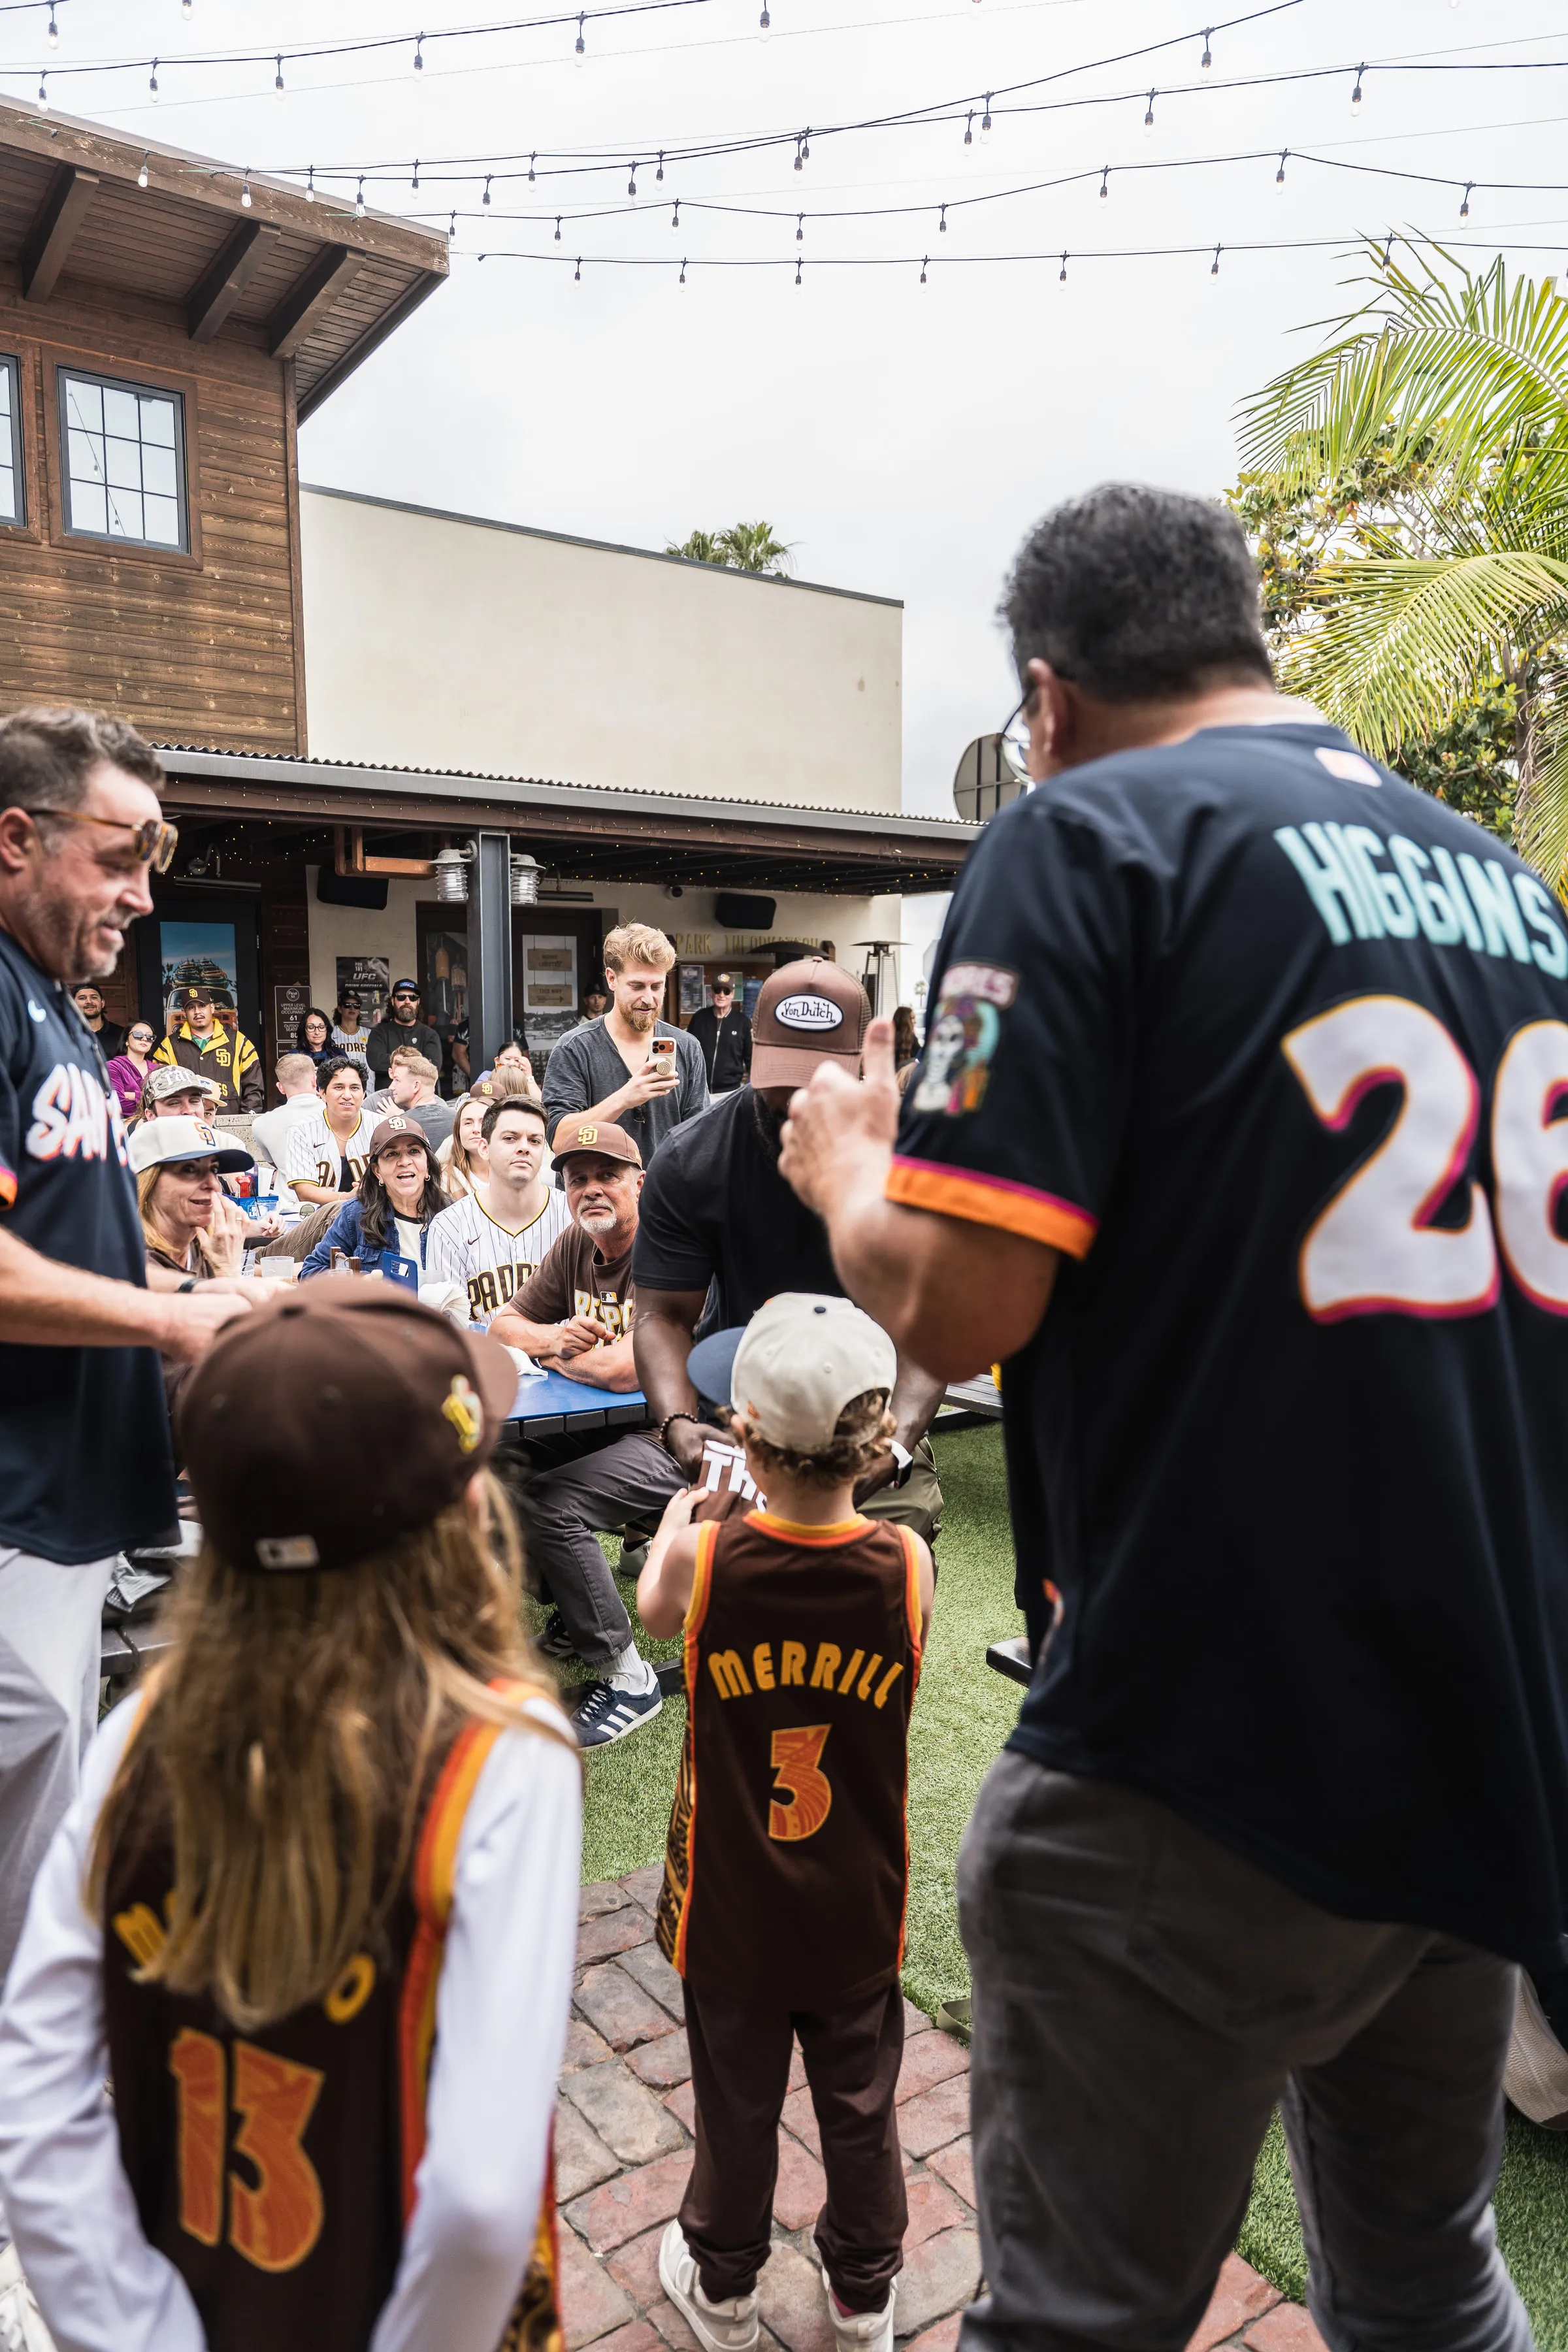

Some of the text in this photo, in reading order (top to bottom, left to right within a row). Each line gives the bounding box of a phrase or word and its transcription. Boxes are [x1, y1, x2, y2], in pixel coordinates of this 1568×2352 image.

[1273, 821, 1568, 979] HIGGINS
[675, 933, 712, 955] PARK
[784, 1001, 836, 1024] Von Dutch
[216, 1049, 231, 1067] SD
[482, 1082, 493, 1095] SD
[194, 1122, 216, 1147] SD
[389, 1116, 407, 1131] SD
[578, 1125, 598, 1146] SD
[708, 1640, 904, 1710] MERRILL
[768, 1723, 832, 1842] 3
[169, 2027, 325, 2274] 13
